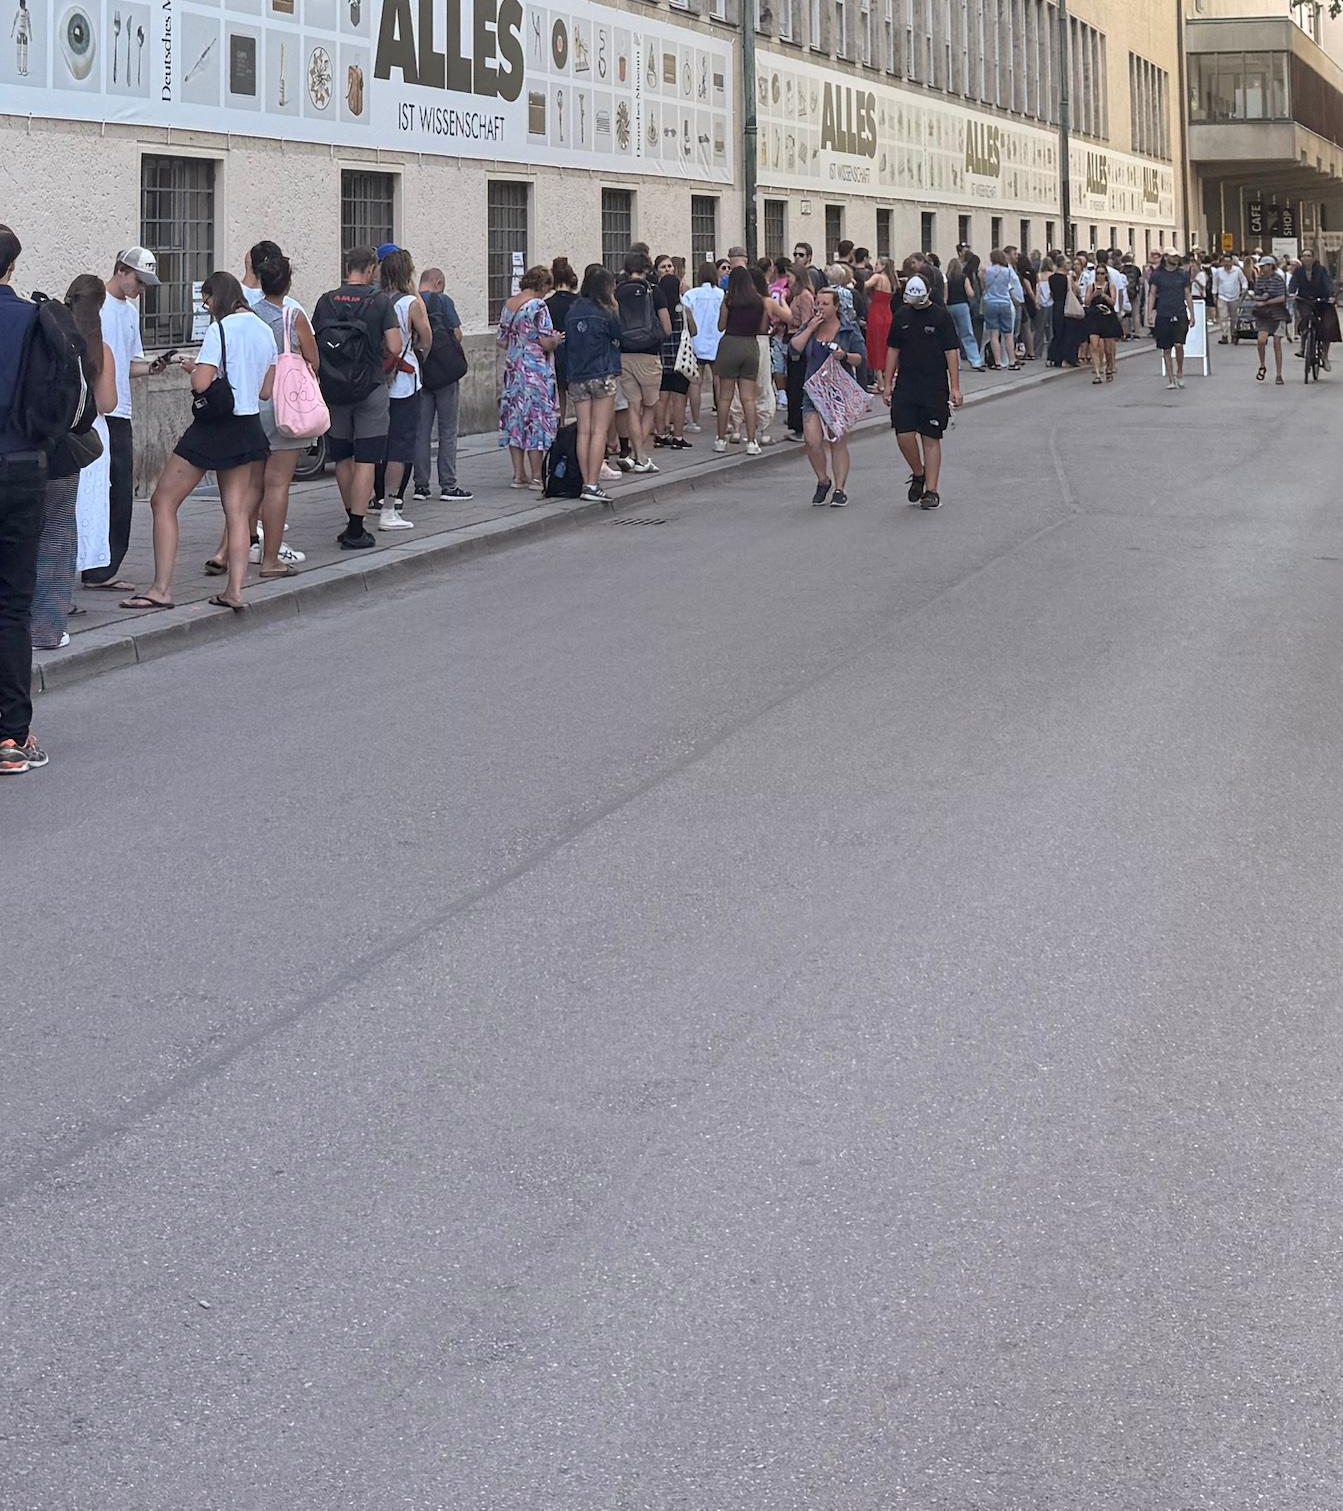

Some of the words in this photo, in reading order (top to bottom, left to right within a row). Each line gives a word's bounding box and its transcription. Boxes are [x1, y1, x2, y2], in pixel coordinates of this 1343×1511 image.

[161, 16, 173, 103] Deutsches
[397, 102, 416, 132] IST
[418, 105, 506, 142] WISSENSCHAFT
[821, 81, 877, 159] ALLES
[965, 119, 1001, 179] ALLES
[1086, 151, 1108, 196] ALLES
[1283, 210, 1293, 236] SHOP
